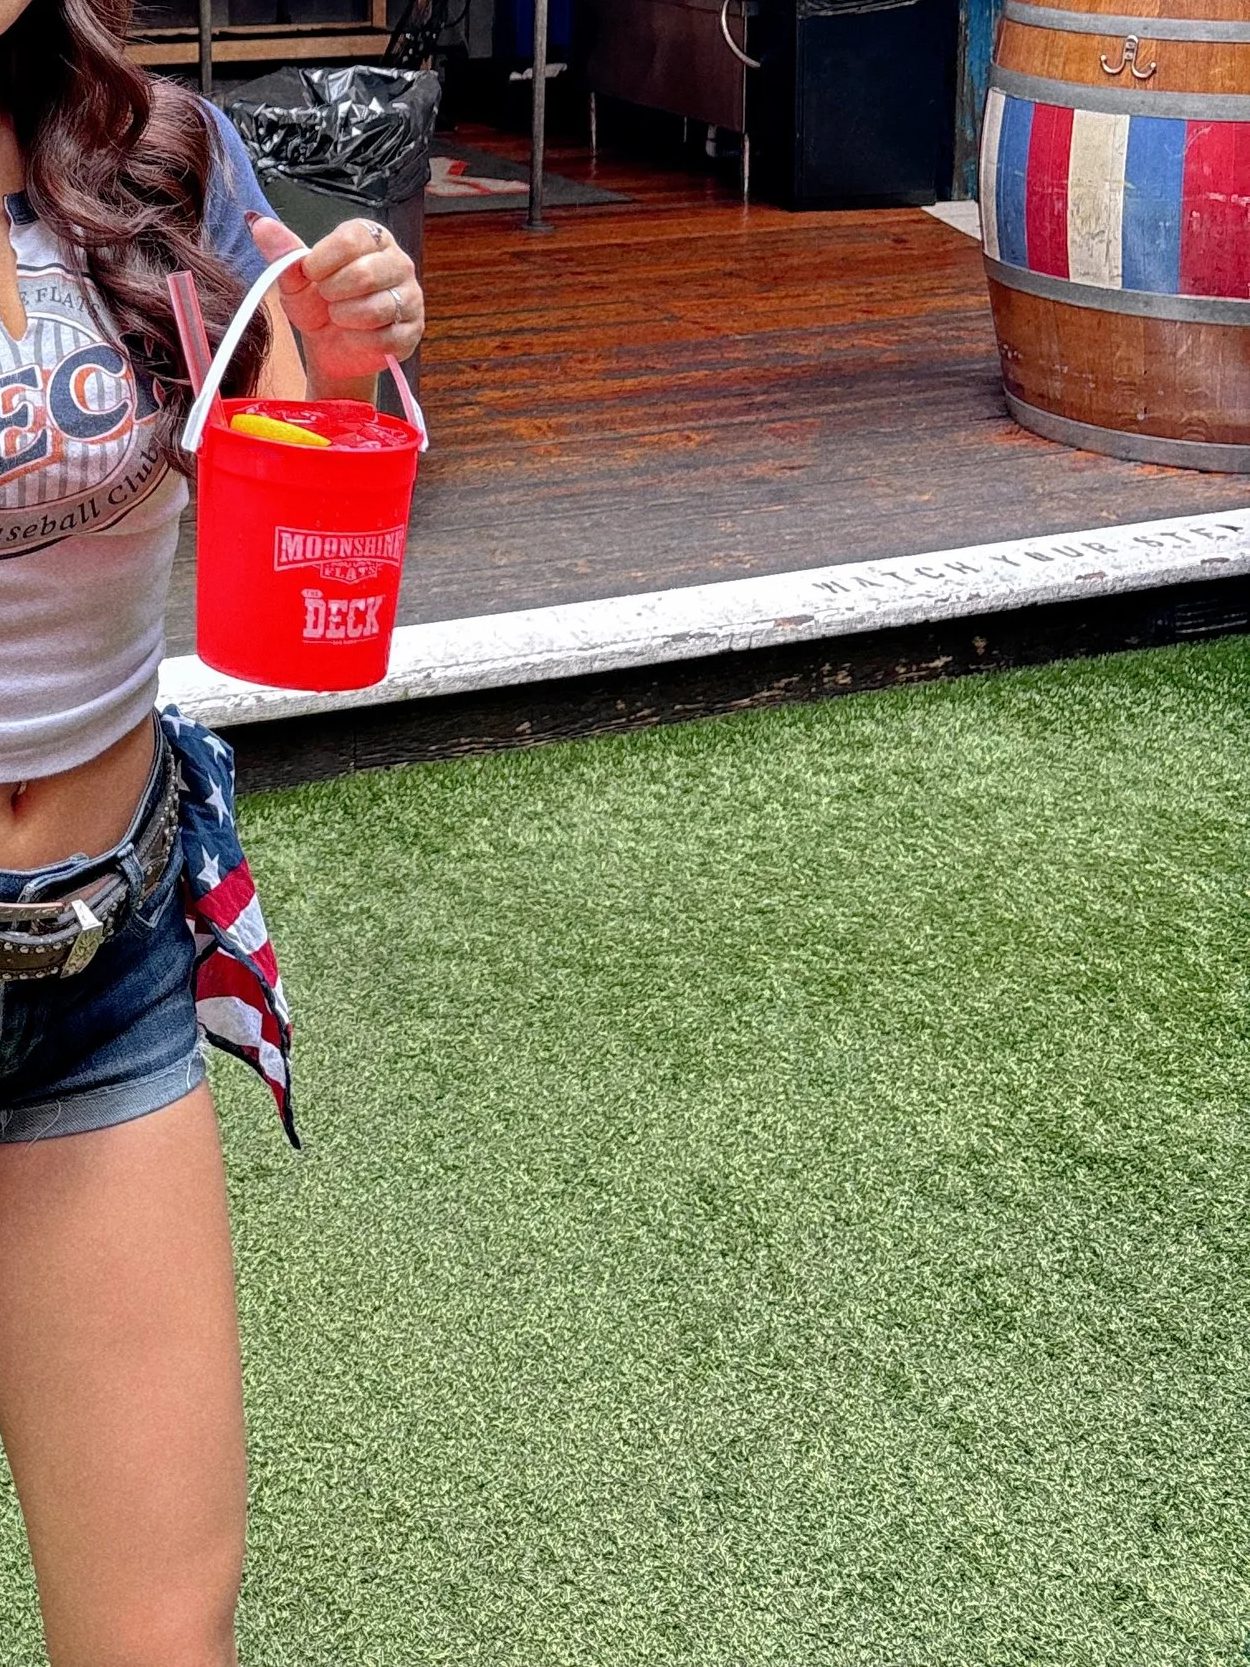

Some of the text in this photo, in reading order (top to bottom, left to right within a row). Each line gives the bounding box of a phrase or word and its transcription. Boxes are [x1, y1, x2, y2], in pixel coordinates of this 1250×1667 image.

[106, 447, 162, 506] Club
[991, 541, 1118, 569] YOUR
[302, 594, 384, 639] DECK
